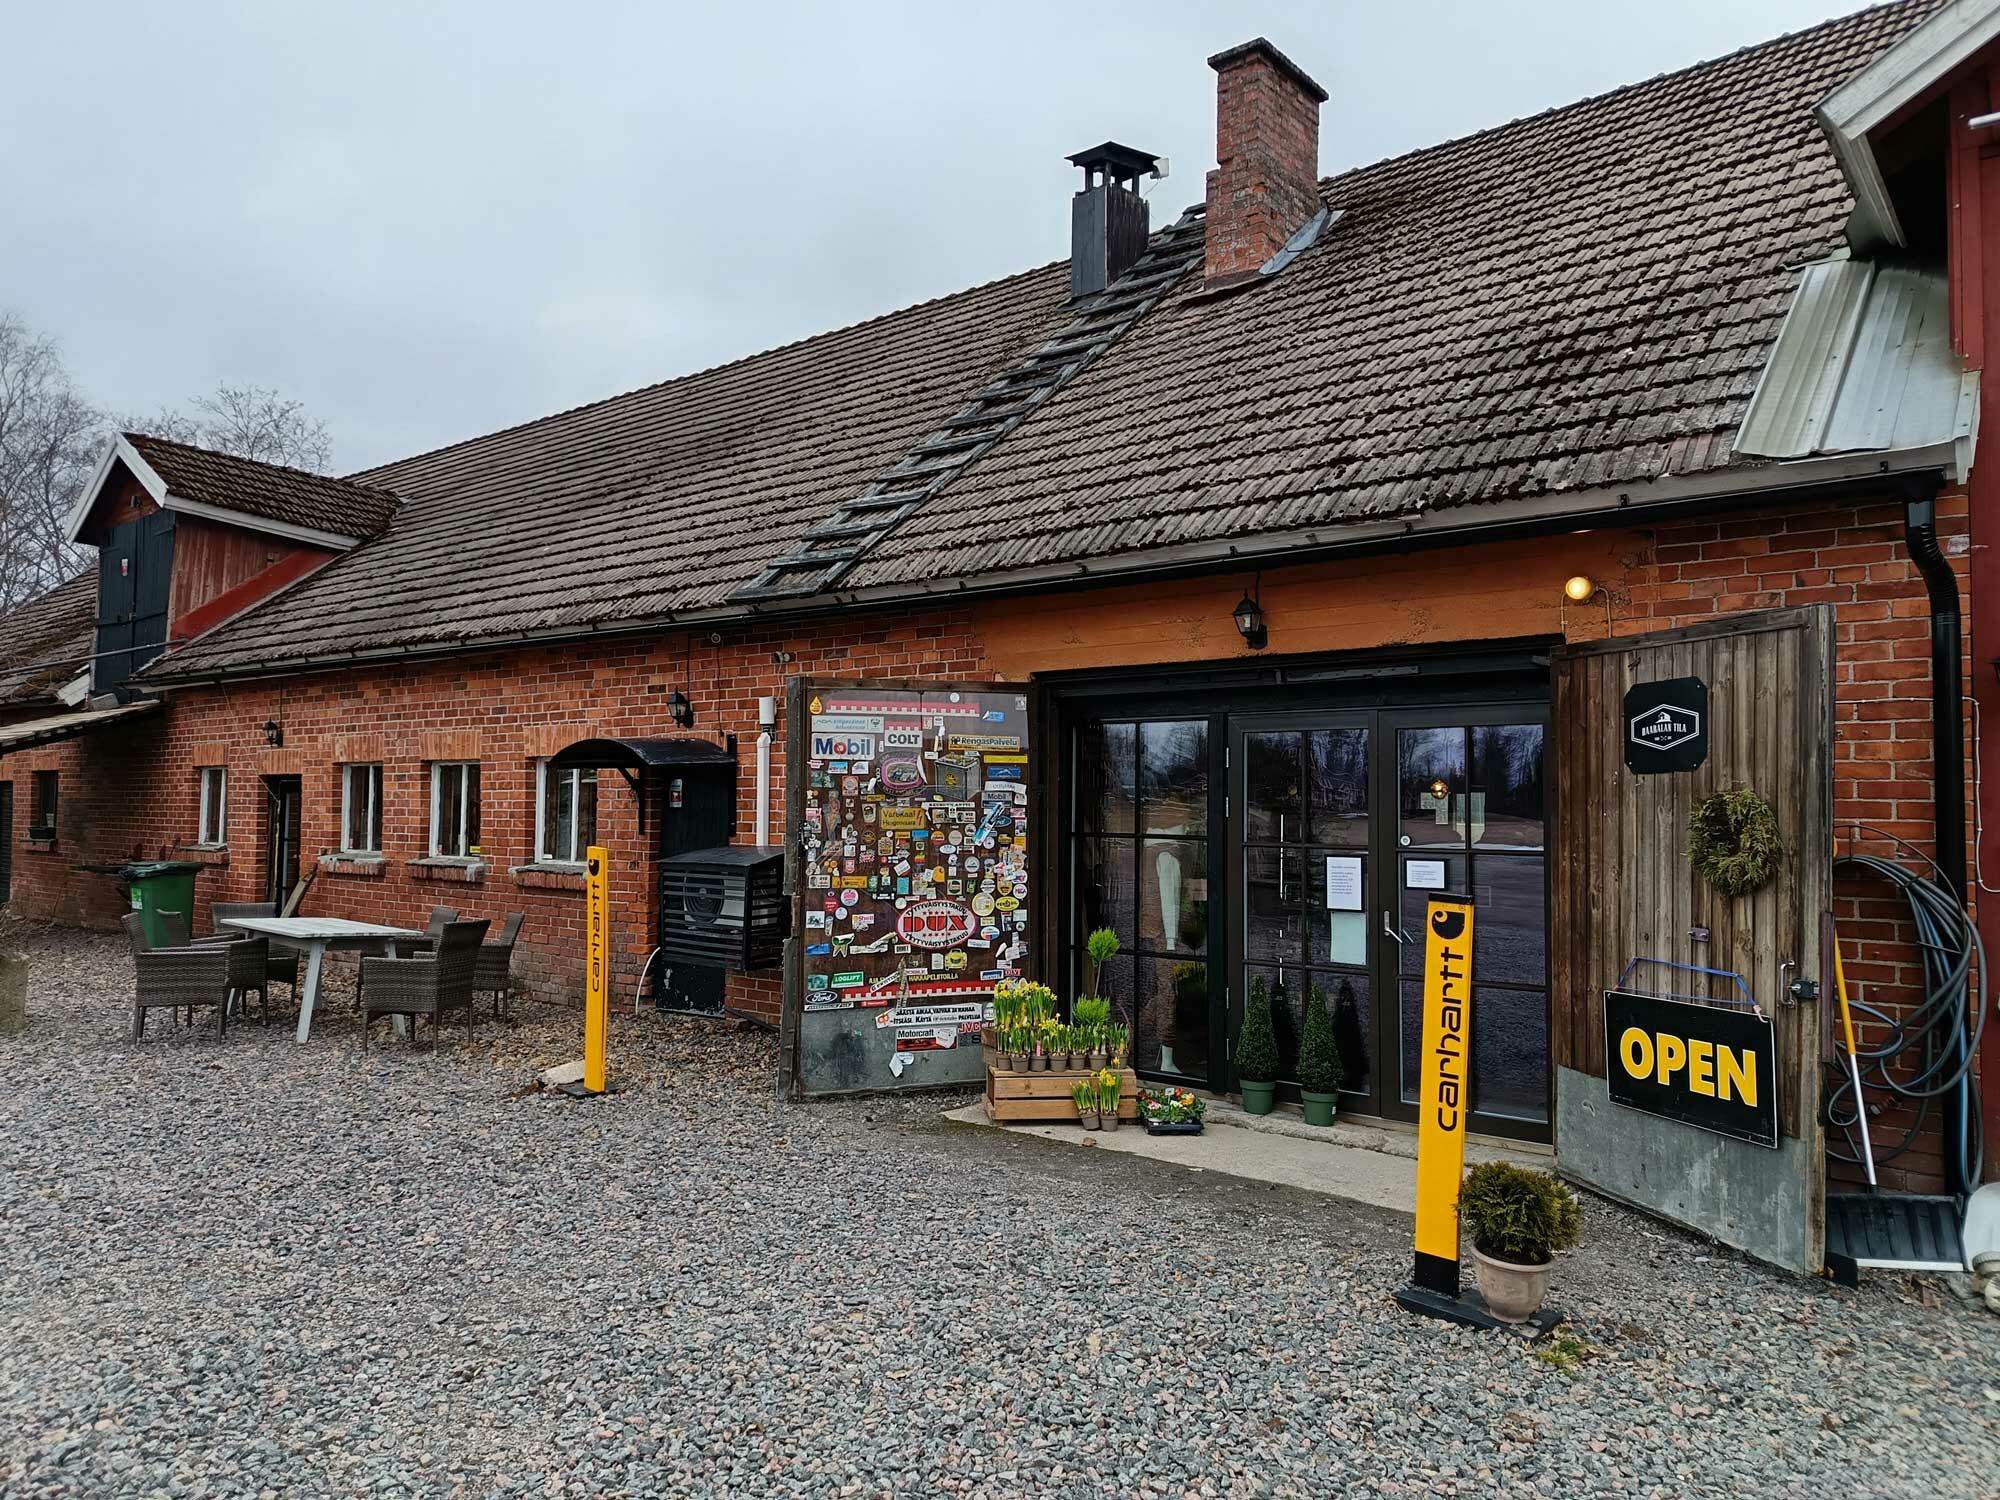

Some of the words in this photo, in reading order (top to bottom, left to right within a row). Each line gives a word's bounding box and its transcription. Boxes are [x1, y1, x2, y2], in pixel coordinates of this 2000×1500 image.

[1673, 723, 1687, 733] TILA
[888, 734, 919, 745] COLT
[962, 737, 1017, 746] RengasPalvelu
[815, 738, 871, 756] Mobil
[903, 915, 968, 932] DUX
[592, 880, 600, 992] carhartt
[909, 973, 959, 982] HAKKAPELIITOILLA
[1005, 968, 1020, 976] OLVI
[812, 992, 832, 1002] Ford
[959, 1021, 981, 1034] JVC
[898, 1029, 934, 1038] Motorcraft
[1436, 947, 1464, 1132] carhartt
[1620, 1027, 1757, 1107] OPEN
